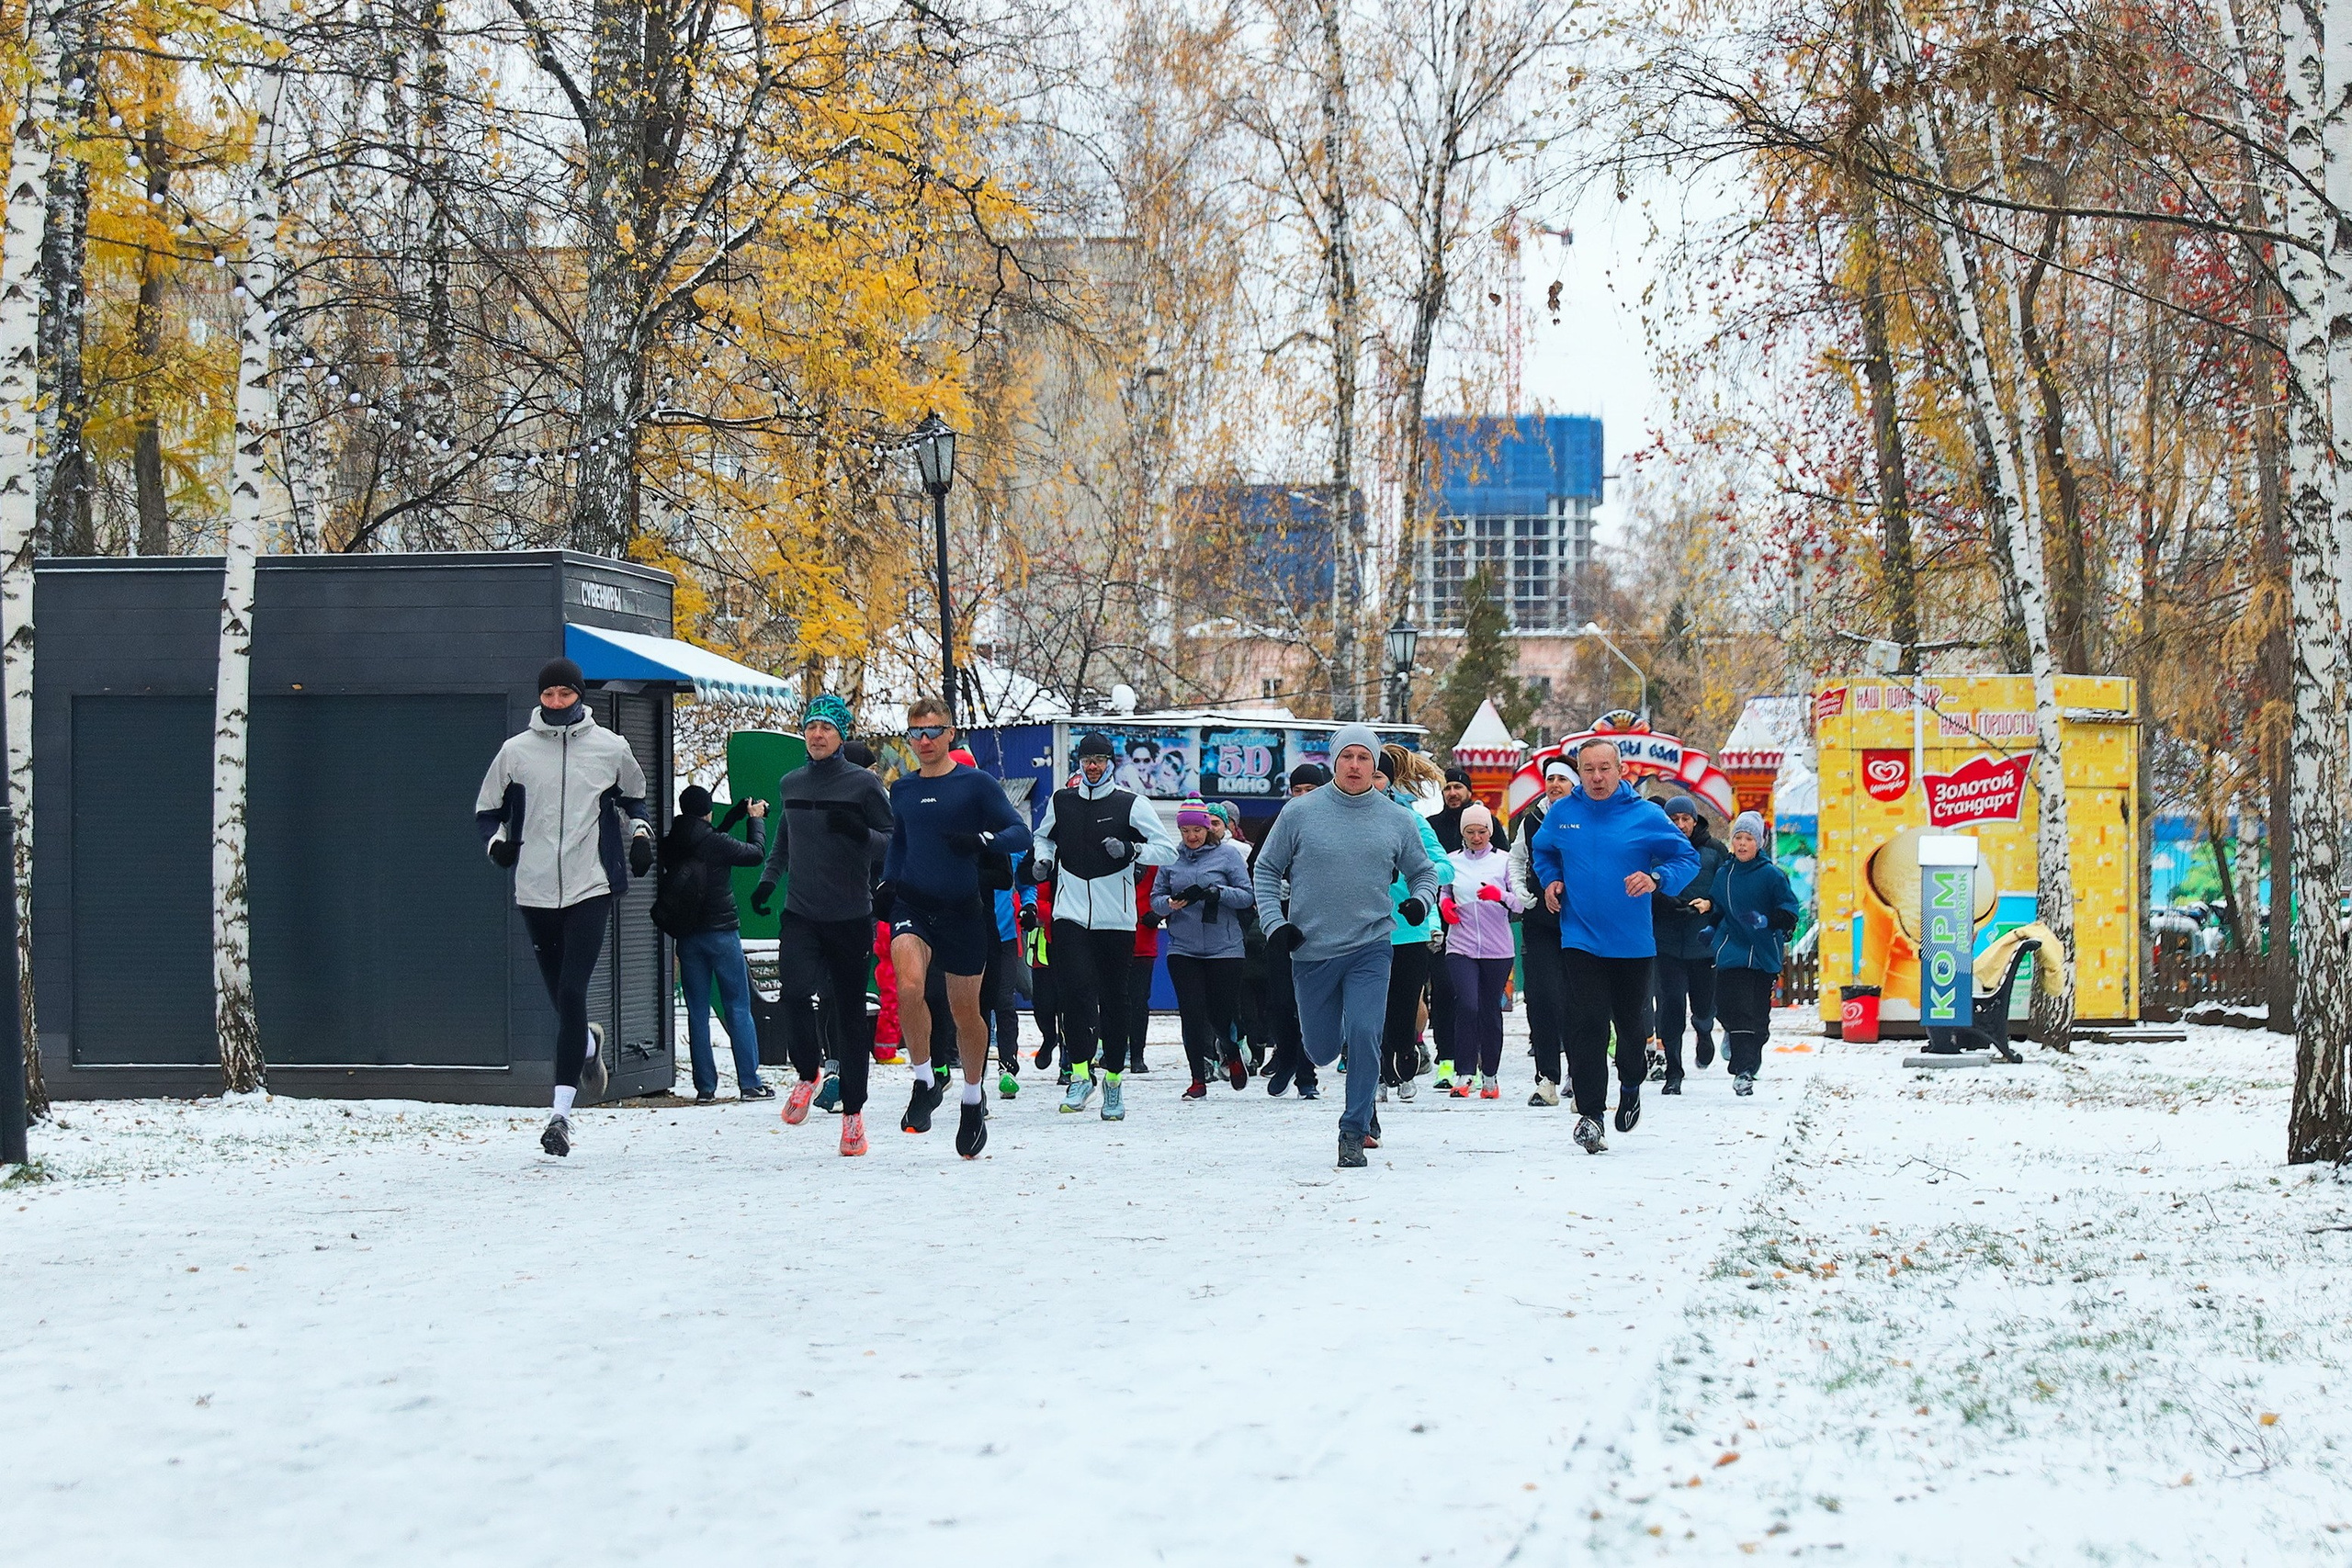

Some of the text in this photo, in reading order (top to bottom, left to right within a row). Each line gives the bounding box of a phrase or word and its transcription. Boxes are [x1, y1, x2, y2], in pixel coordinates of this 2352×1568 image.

[581, 581, 622, 612] СУВЕНИРЫ
[1856, 687, 1880, 710] НАШ
[1977, 713, 2037, 737] ГОРДОСТЬ
[1217, 745, 1272, 778] 5D
[1217, 777, 1272, 794] КИНО
[1934, 769, 2015, 802] Золотой
[1934, 792, 2016, 818] Стандарт
[1930, 871, 1956, 1020] КОРМ
